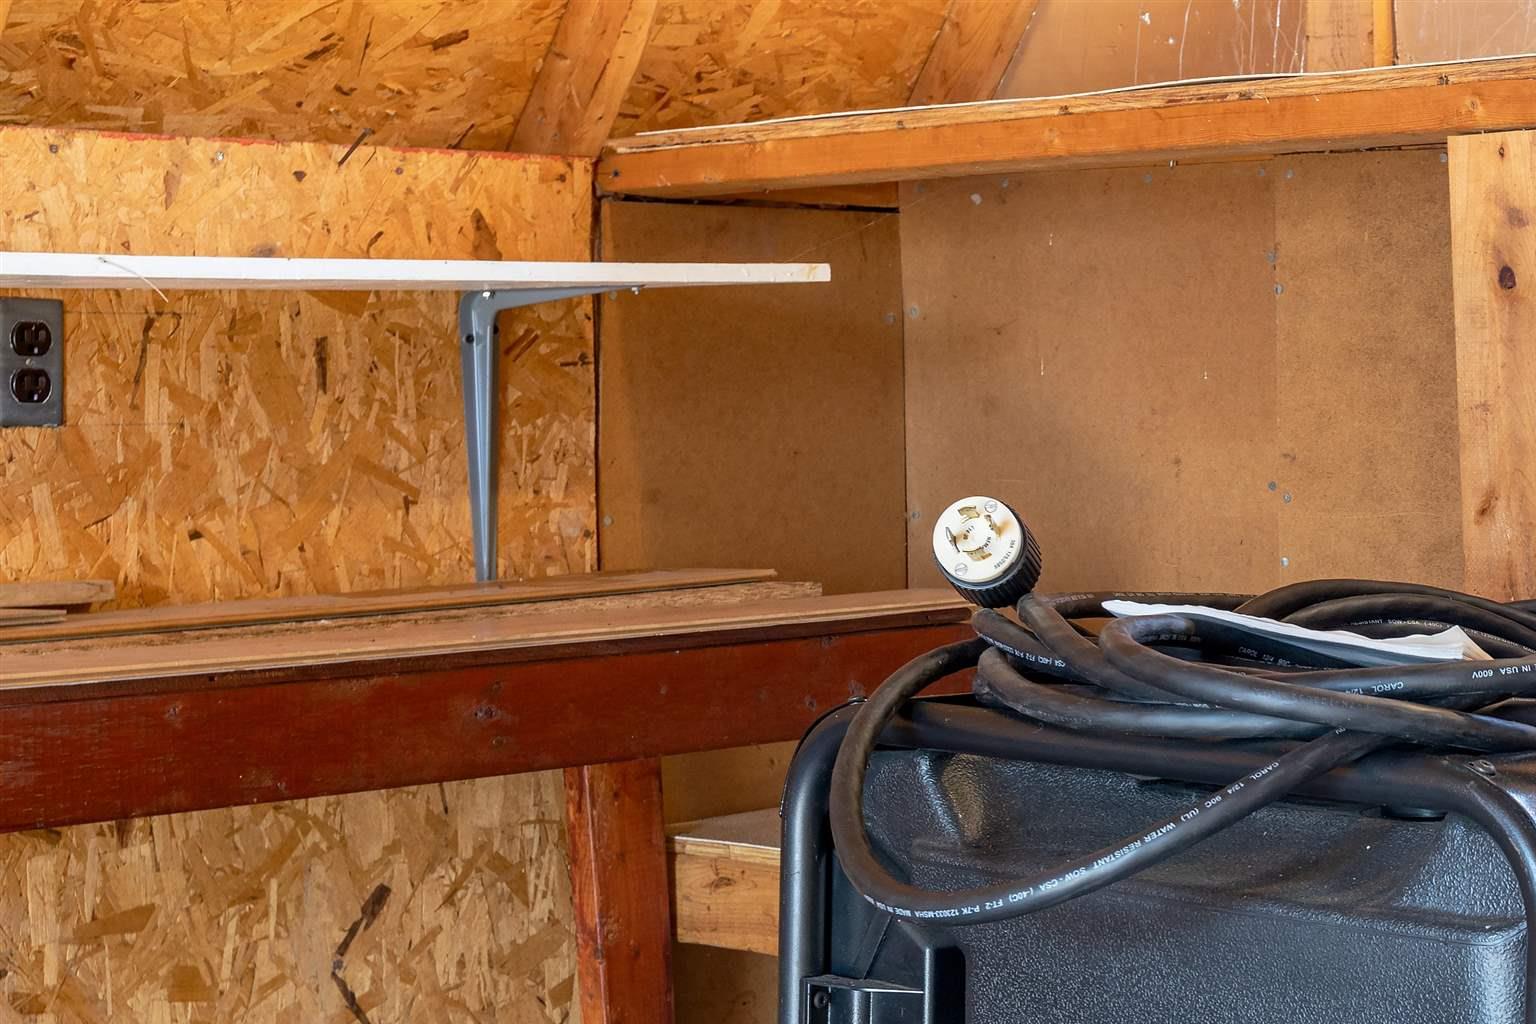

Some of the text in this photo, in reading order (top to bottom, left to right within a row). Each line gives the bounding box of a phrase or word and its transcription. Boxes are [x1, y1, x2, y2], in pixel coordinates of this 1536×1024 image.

[1472, 669, 1494, 679] 600V
[1500, 665, 1519, 675] USA
[1522, 664, 1532, 672] IN
[1372, 681, 1404, 693] CAROL
[1249, 762, 1280, 780] CAROL
[1226, 782, 1244, 794] 12/4
[1204, 796, 1222, 808] 90C
[1180, 808, 1199, 822] (UL)
[1144, 822, 1176, 842] WATER
[1093, 840, 1142, 868] RESISTANT
[1008, 888, 1034, 903] (-40C)
[961, 905, 980, 915] P-7K
[985, 899, 1004, 910] FT-2
